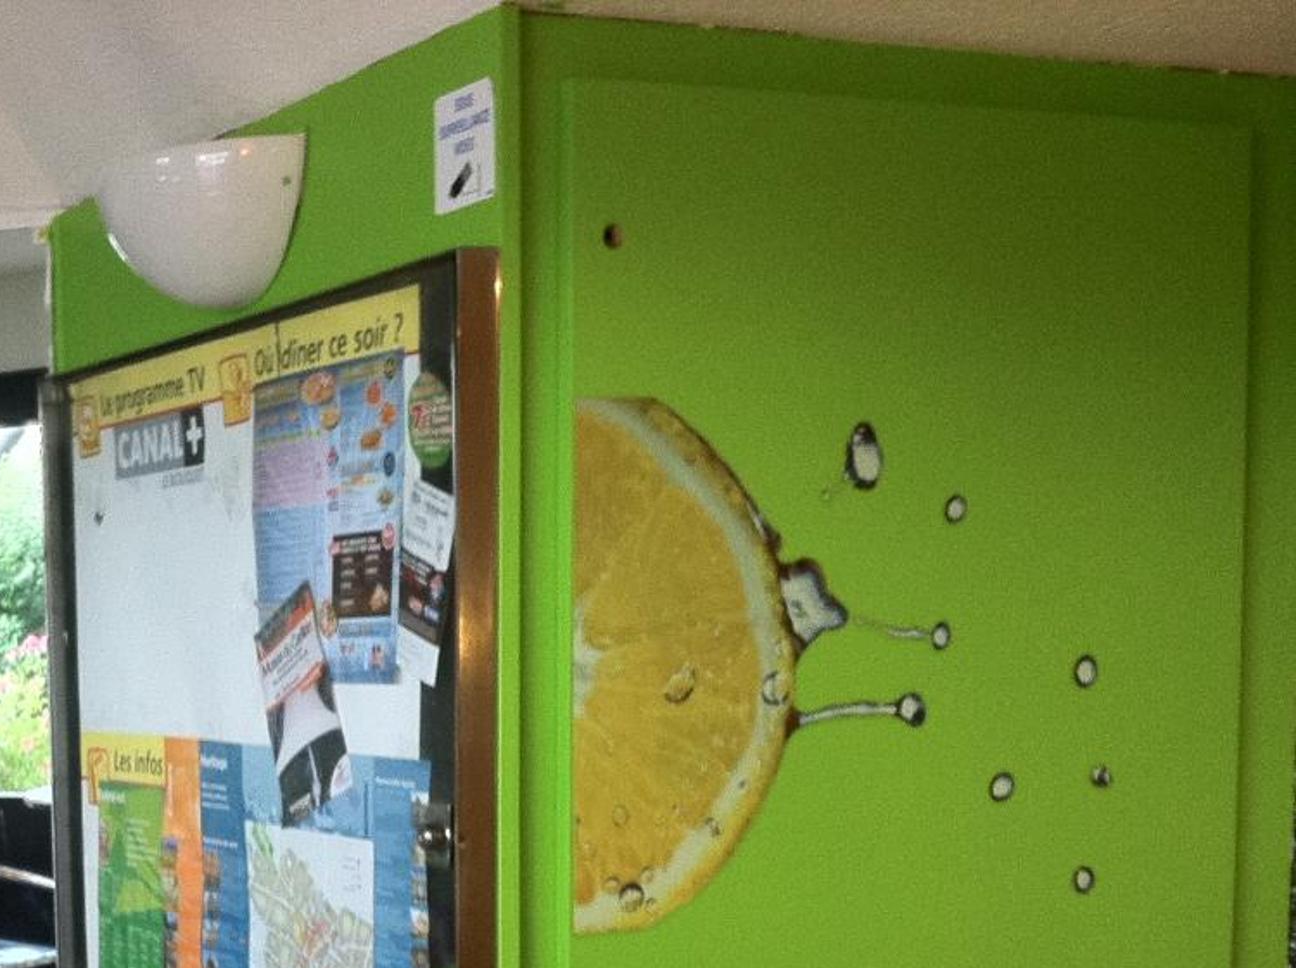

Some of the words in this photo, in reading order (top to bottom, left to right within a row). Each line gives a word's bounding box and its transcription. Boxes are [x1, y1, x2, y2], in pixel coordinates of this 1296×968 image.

[328, 333, 348, 358] ce
[354, 316, 389, 352] soir
[395, 312, 404, 343] ?
[115, 377, 185, 418] programme
[186, 365, 205, 395] TV
[114, 749, 132, 773] Les
[134, 749, 163, 777] infos
